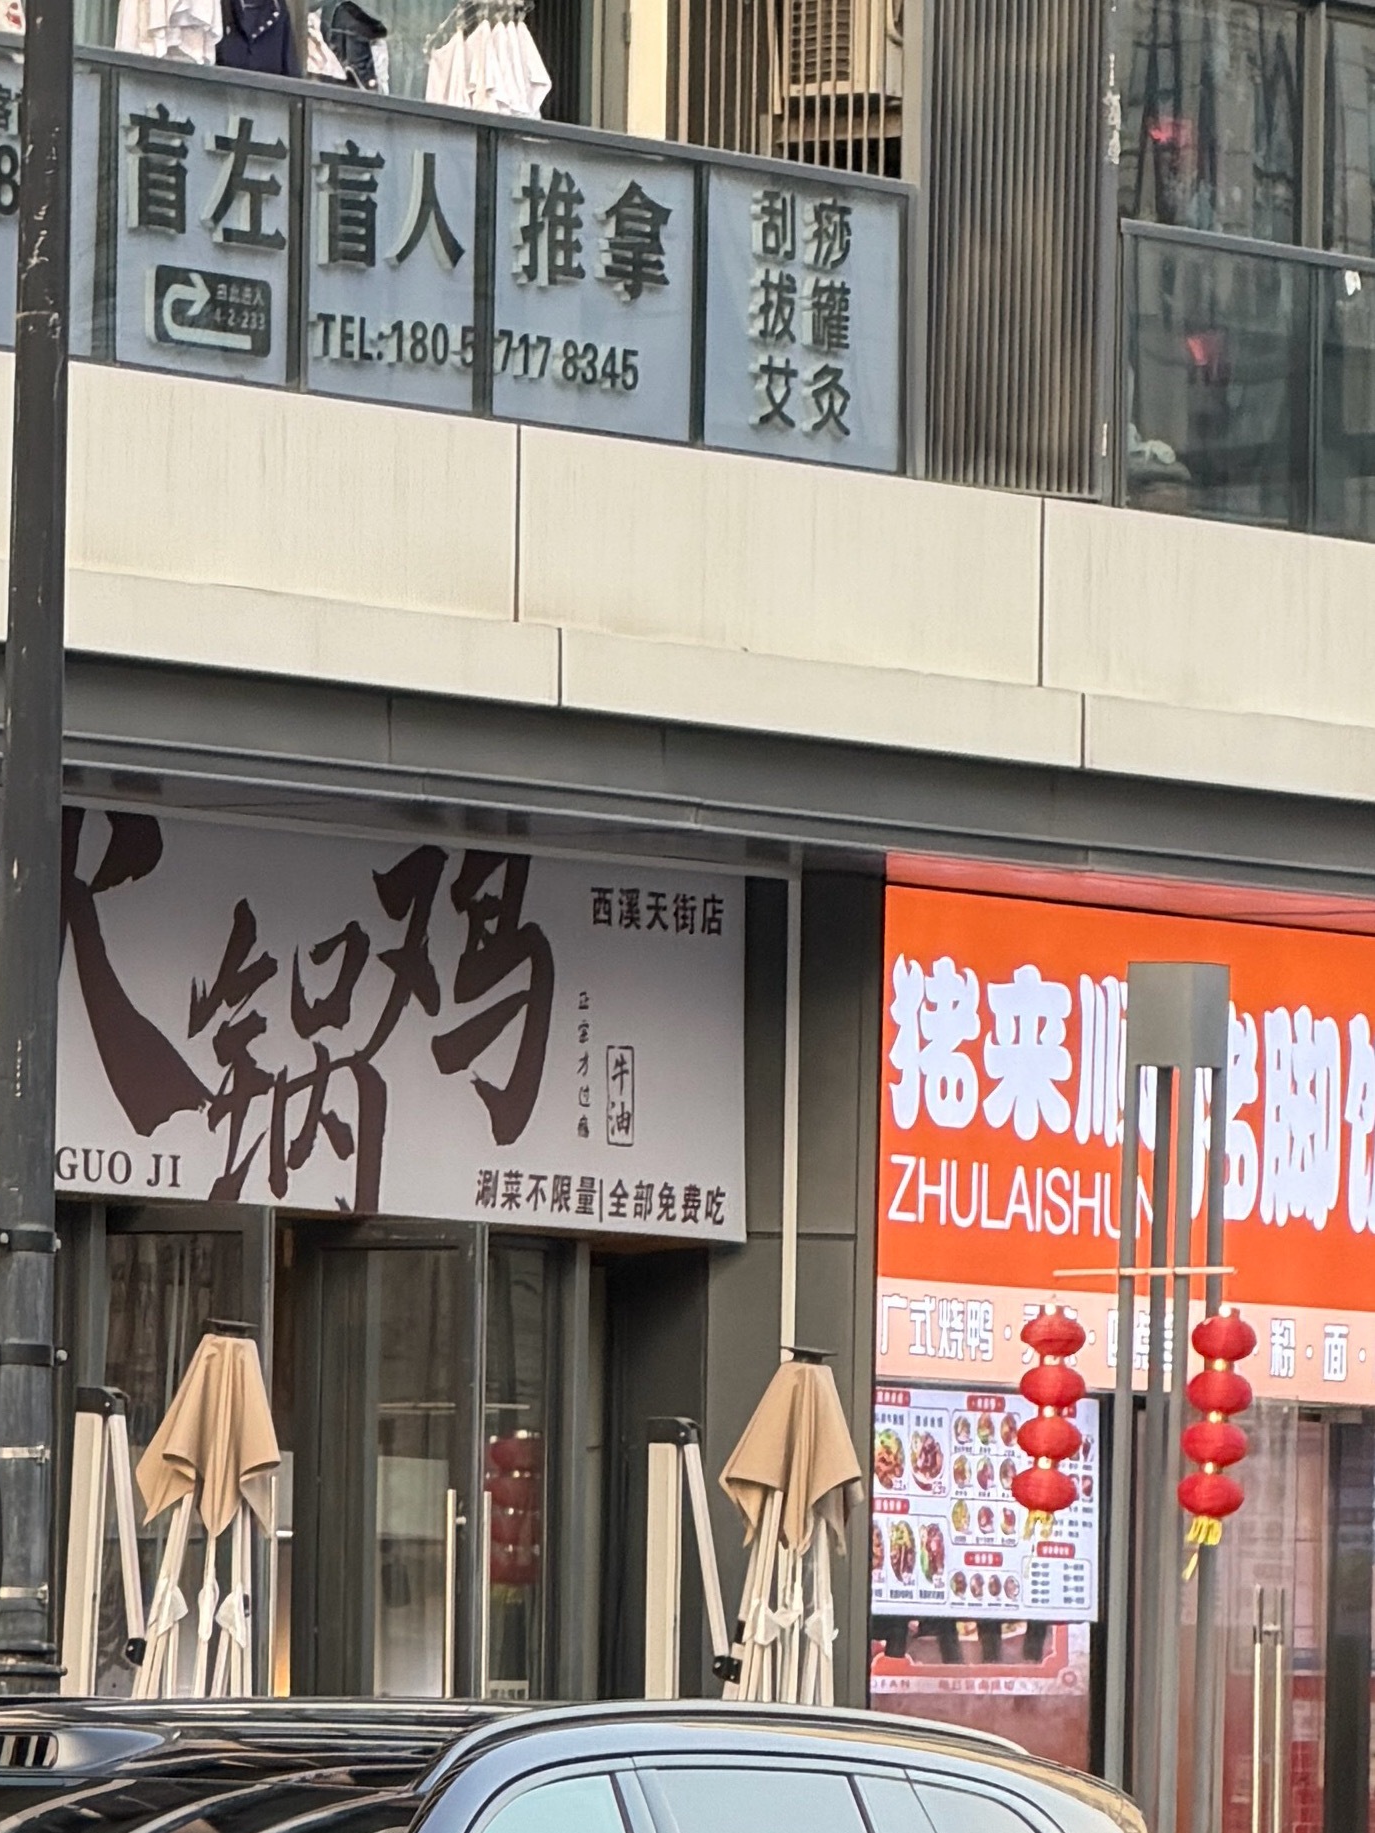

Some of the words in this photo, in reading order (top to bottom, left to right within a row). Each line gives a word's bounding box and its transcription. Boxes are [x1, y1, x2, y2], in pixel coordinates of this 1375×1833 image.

[759, 190, 852, 270] 刮痧
[758, 272, 851, 351] 拔罐
[561, 339, 639, 391] 8345
[757, 357, 852, 436] 艾灸
[591, 886, 724, 936] 西溪天街店
[608, 1053, 632, 1136] 牛油
[56, 1146, 132, 1185] GUO
[147, 1154, 181, 1188] JI
[881, 1295, 994, 1362] 广式烧鸭
[1323, 1324, 1350, 1382] 面
